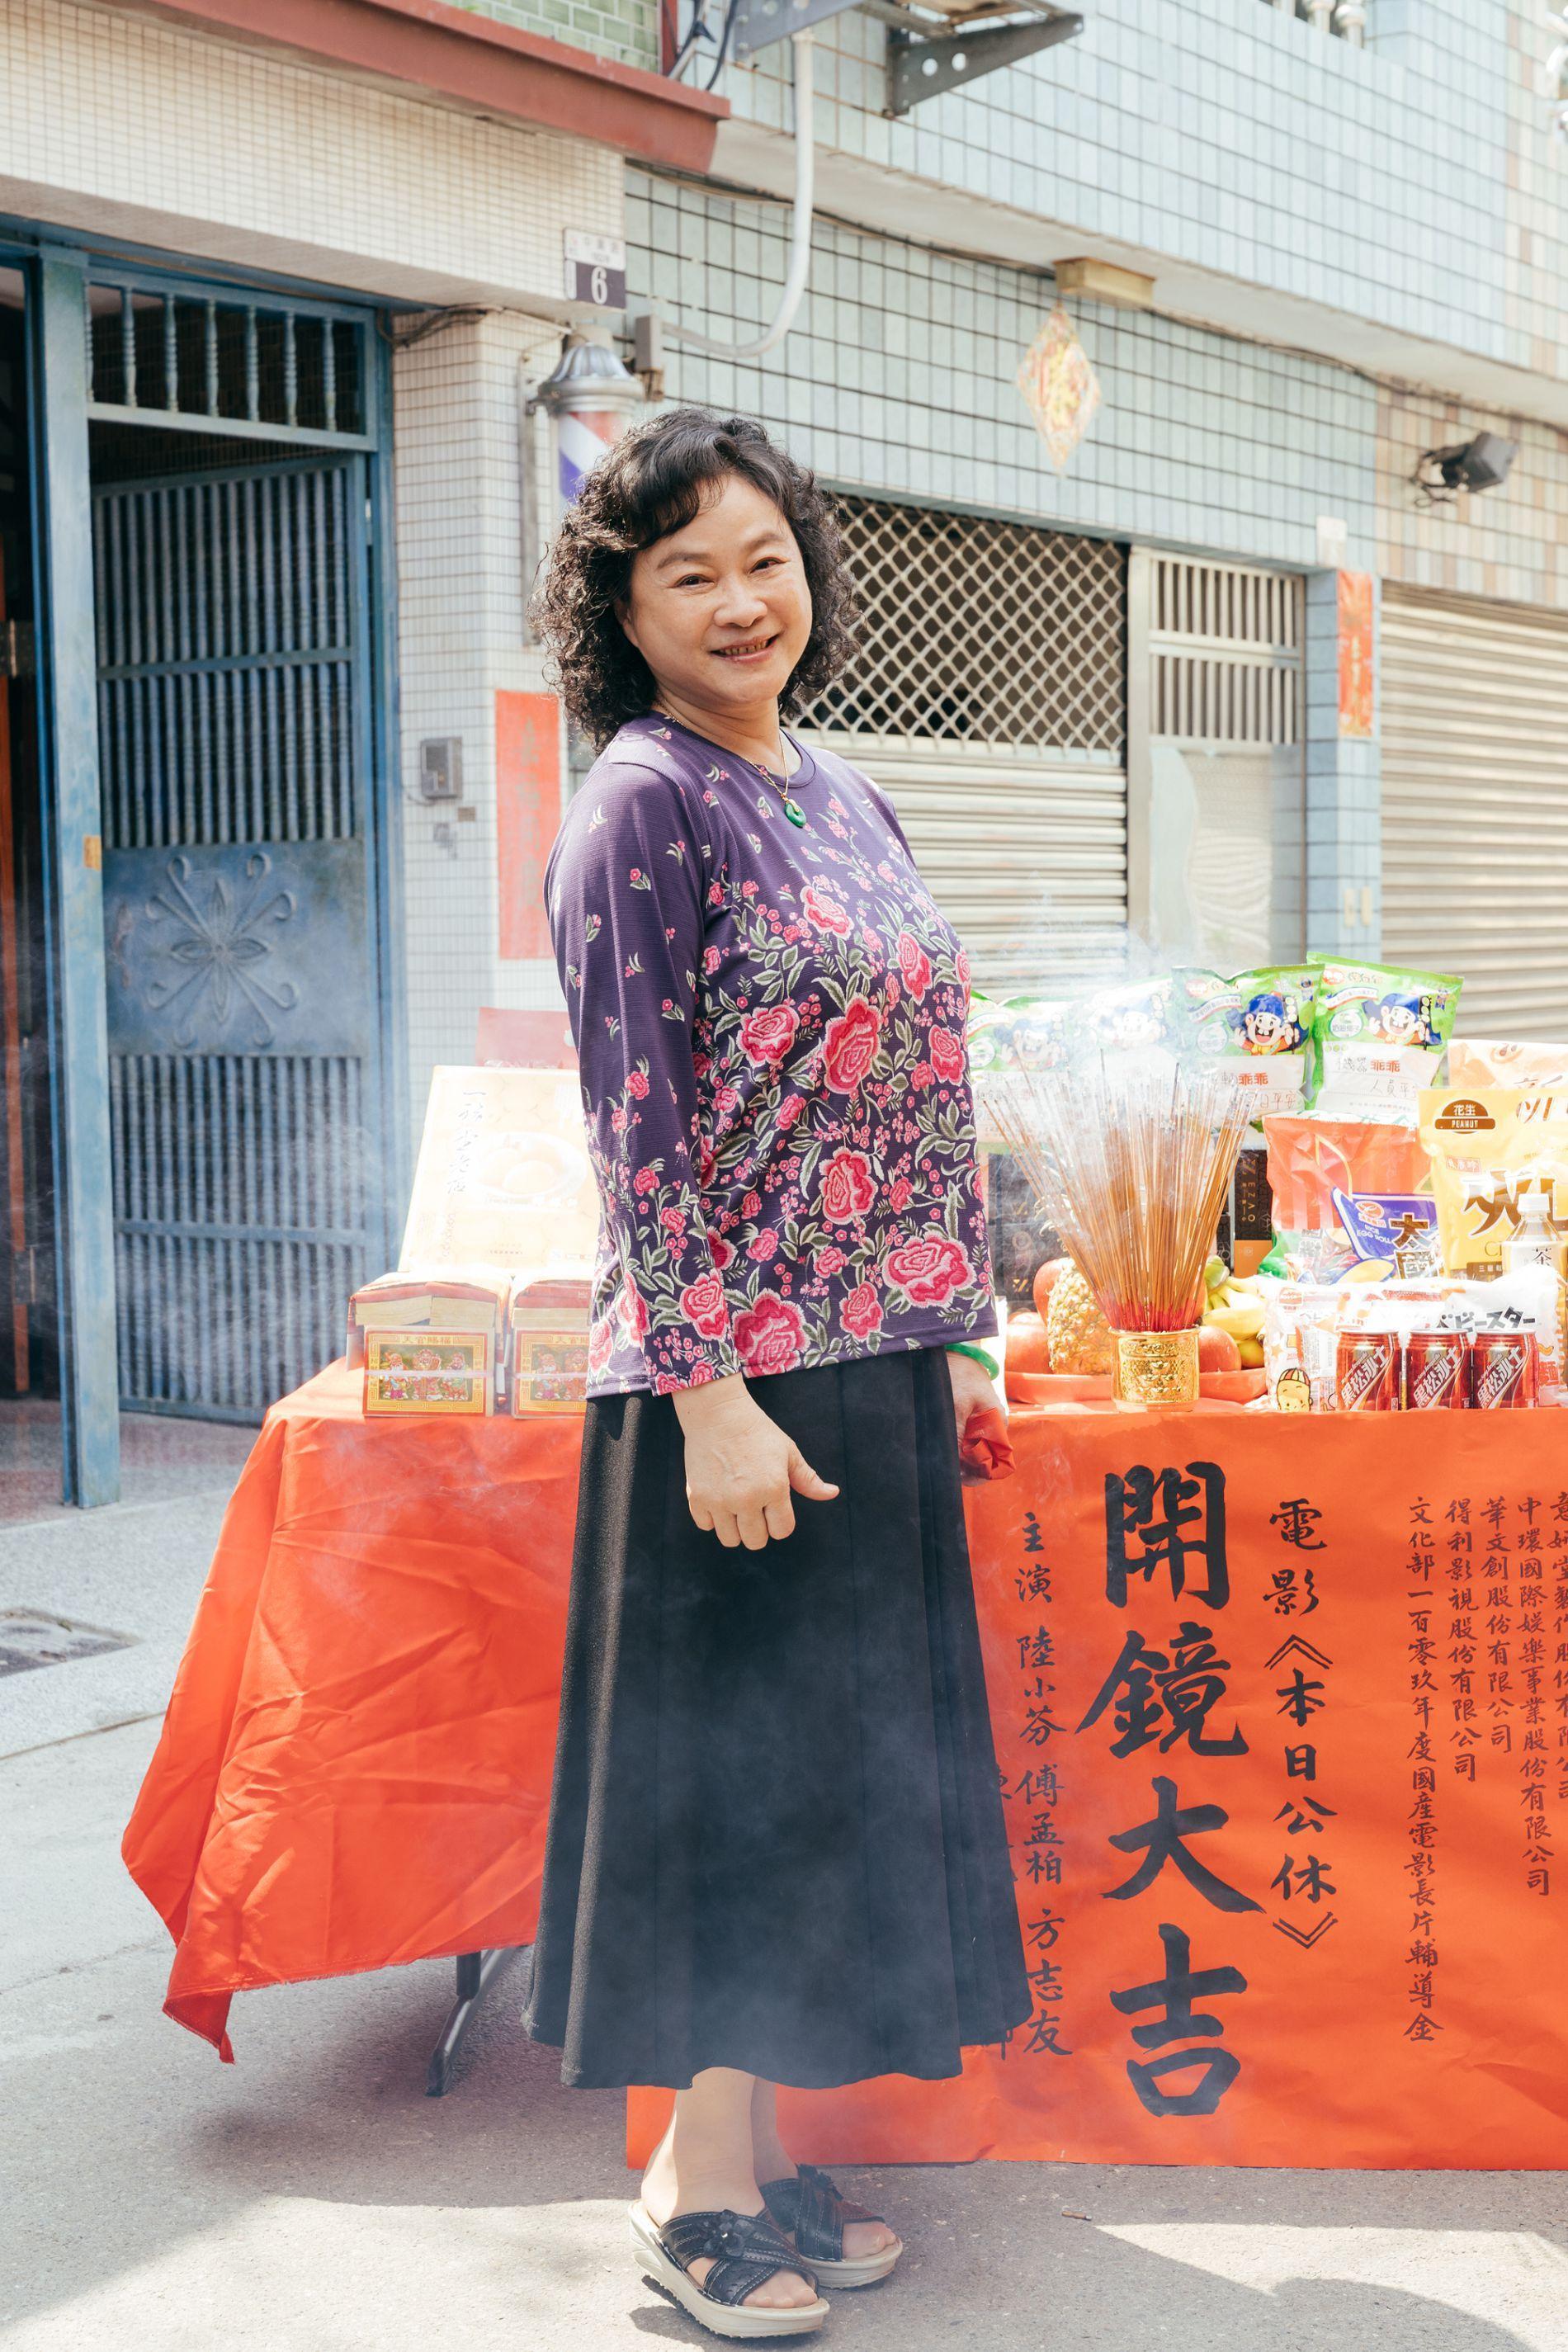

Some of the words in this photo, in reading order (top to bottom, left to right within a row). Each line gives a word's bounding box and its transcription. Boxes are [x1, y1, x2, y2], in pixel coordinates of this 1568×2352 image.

[591, 266, 608, 305] 6
[1451, 1120, 1479, 1128] PEANUT
[1453, 1104, 1476, 1116] 花生
[1532, 1247, 1552, 1267] 茶
[1014, 1512, 1052, 1603] 主演
[1445, 1498, 1482, 1783] 得利影視股份有限公司
[1480, 1495, 1514, 1754] 華文創股份有限公司
[1017, 1625, 1067, 1745] 陸小芬
[1014, 1764, 1065, 1884] 傅孟柏
[1074, 1461, 1267, 2118] 開鏡大吉
[1023, 1908, 1073, 2056] 方志友
